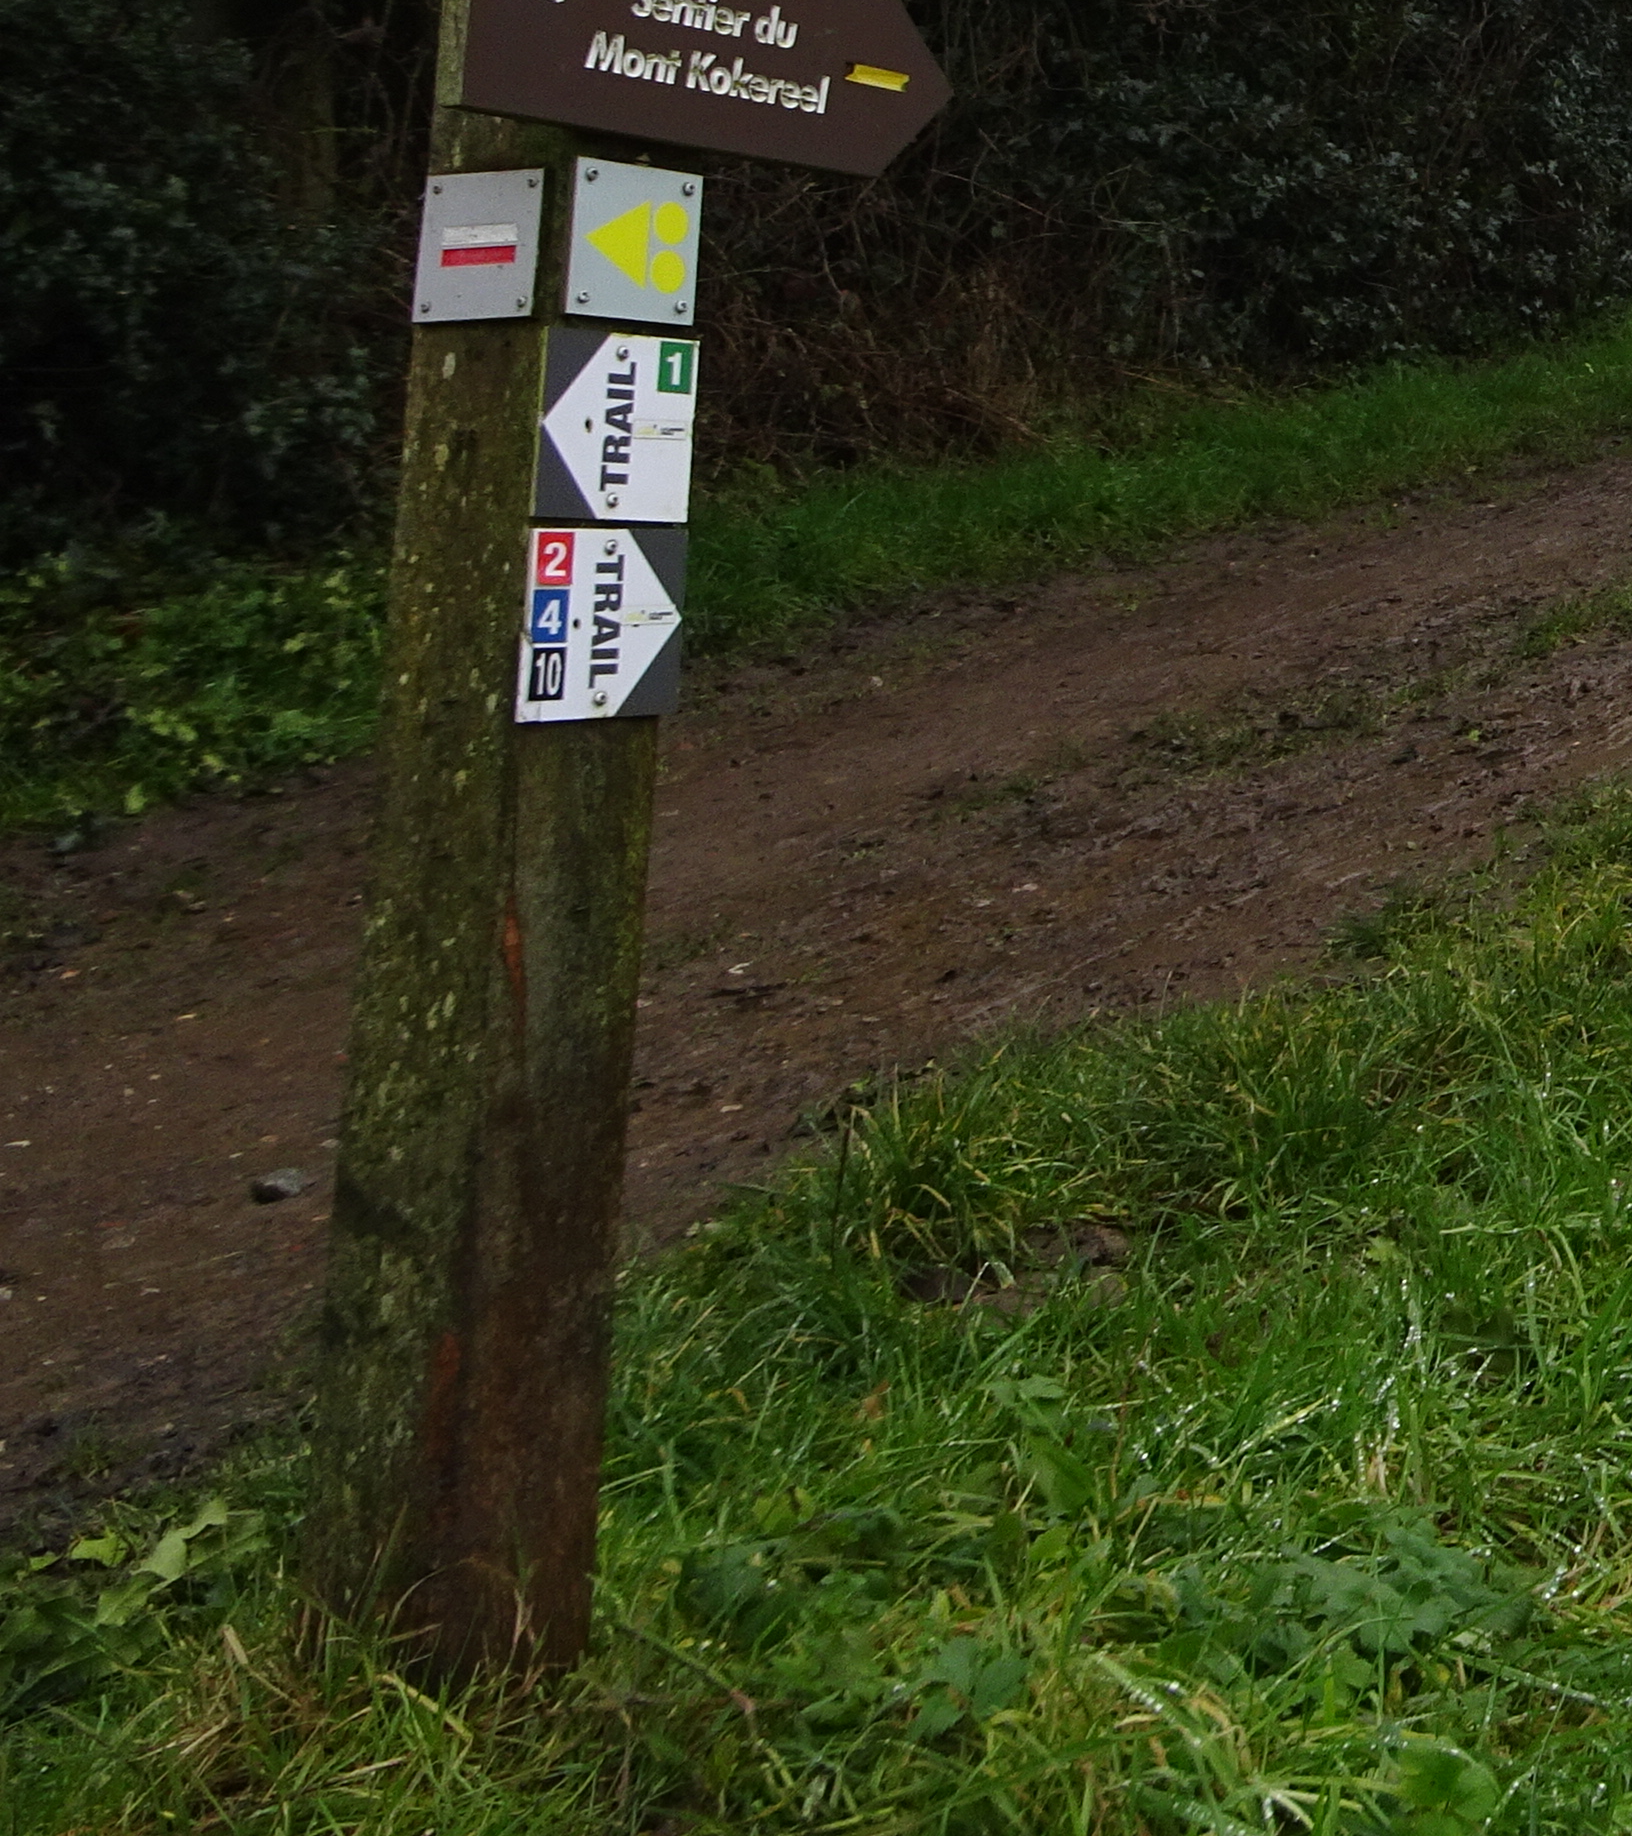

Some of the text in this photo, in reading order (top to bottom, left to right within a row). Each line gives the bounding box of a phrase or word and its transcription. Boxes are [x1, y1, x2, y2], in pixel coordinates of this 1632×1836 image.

[754, 5, 799, 48] du
[585, 30, 831, 114] Mont Kokereel
[665, 352, 682, 386] 1
[599, 361, 637, 492] TRAIL
[543, 541, 567, 577] 2
[537, 599, 562, 635] 4
[588, 554, 625, 689] TRAIL
[536, 652, 562, 696] 10
